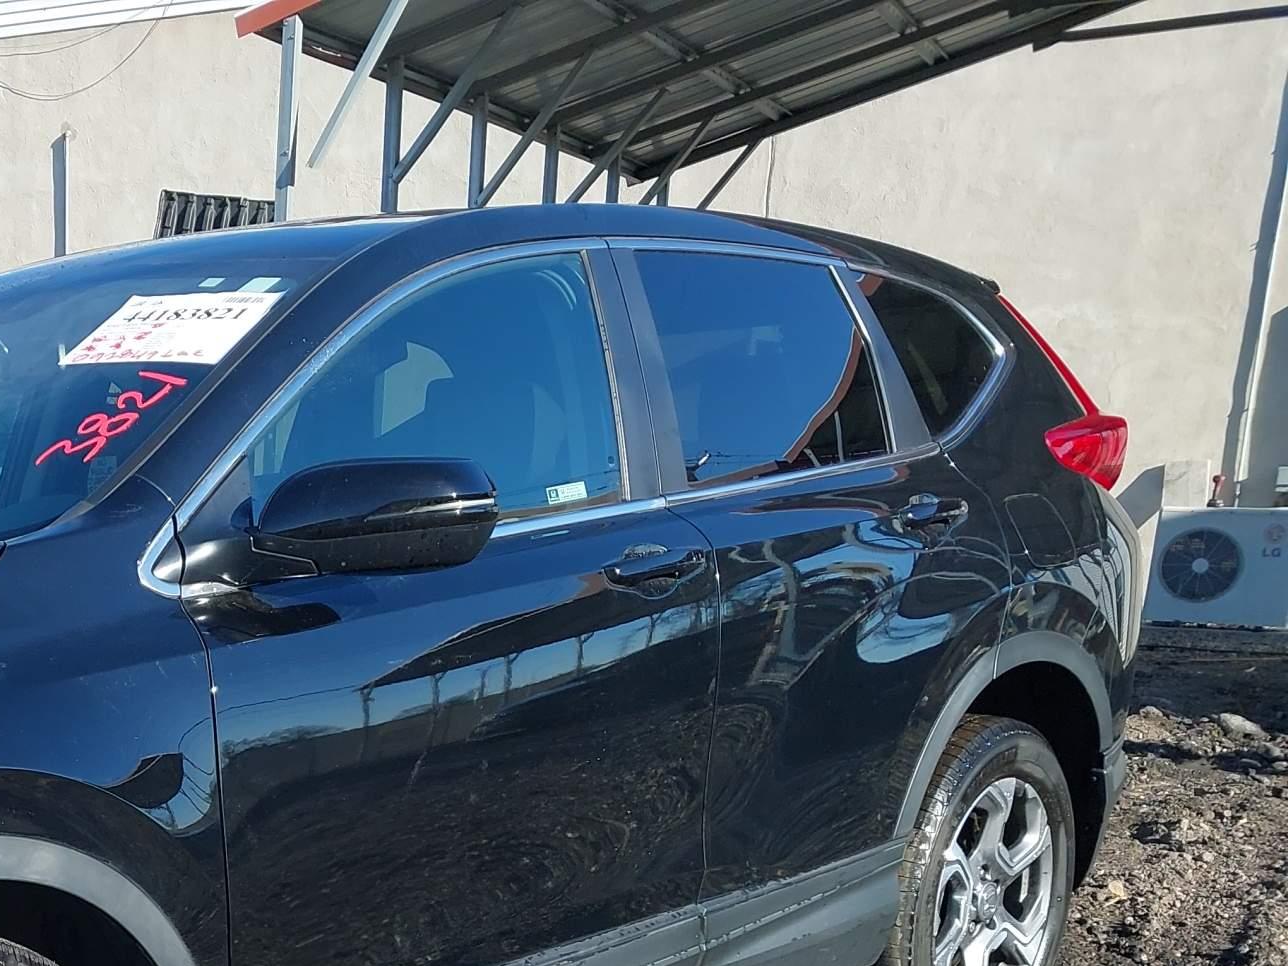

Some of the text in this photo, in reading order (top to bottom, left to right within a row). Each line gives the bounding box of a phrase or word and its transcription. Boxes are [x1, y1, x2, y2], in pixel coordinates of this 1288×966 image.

[123, 307, 248, 322] 44183821
[35, 370, 188, 466] 3821
[1262, 546, 1281, 558] LG
